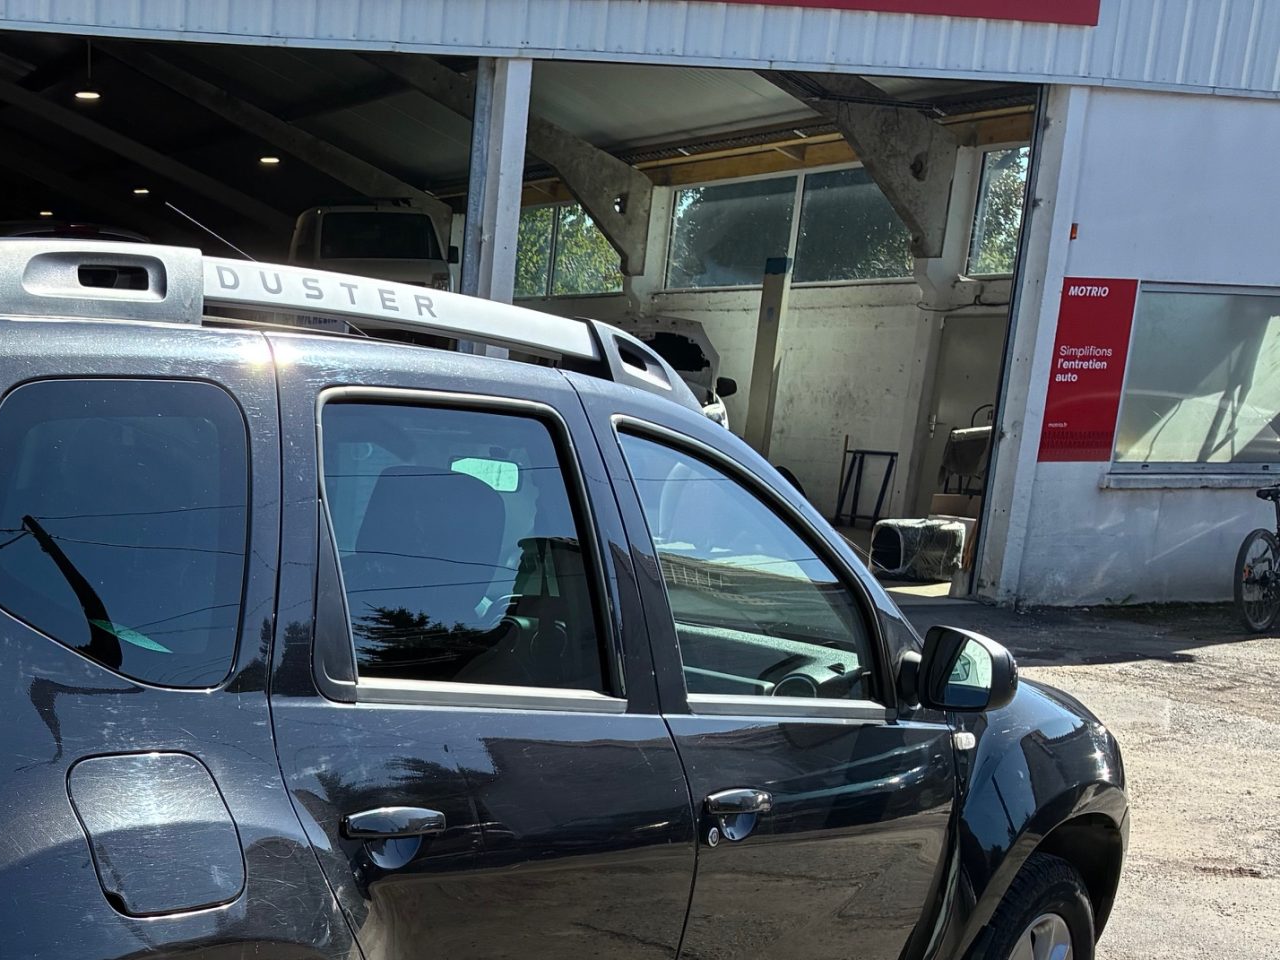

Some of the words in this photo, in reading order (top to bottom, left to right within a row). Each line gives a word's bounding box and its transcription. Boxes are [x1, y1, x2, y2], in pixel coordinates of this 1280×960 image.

[215, 265, 438, 318] DUSTER
[1068, 285, 1110, 297] MOTRIO
[1059, 345, 1113, 358] Simplifions
[1057, 358, 1108, 369] l'entretien
[1055, 372, 1079, 382] auto
